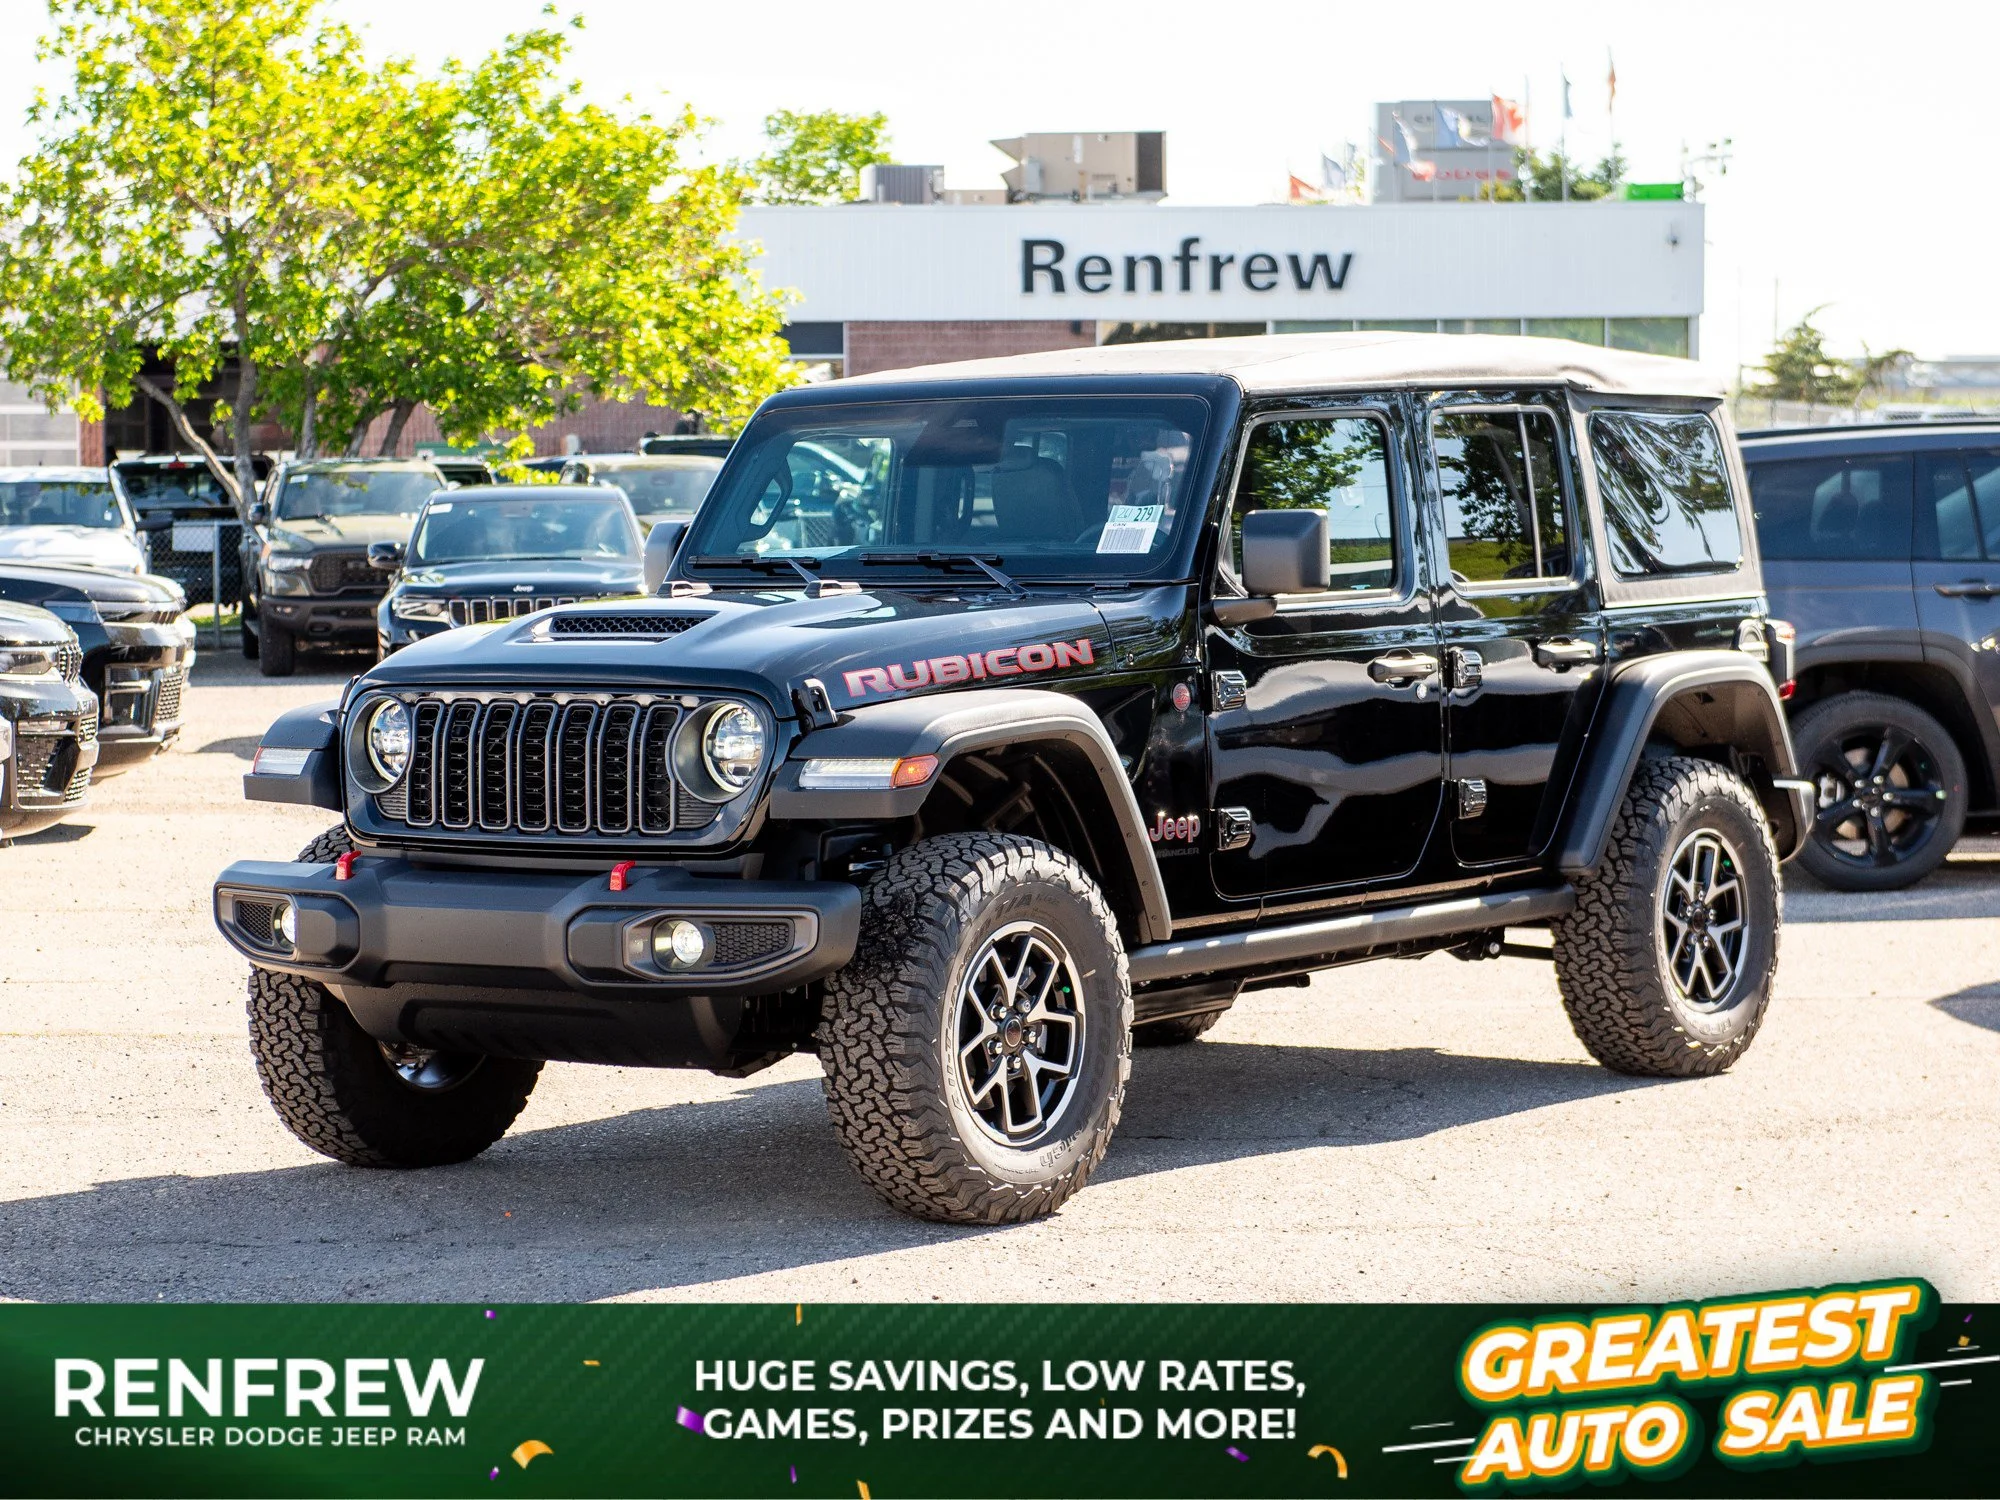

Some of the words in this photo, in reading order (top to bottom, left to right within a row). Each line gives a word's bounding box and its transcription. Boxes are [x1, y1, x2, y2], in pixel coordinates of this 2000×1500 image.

[1021, 236, 1354, 294] Renfrew
[1134, 507, 1154, 522] 279
[842, 638, 1095, 698] RUBICON
[1149, 810, 1201, 843] Jeep
